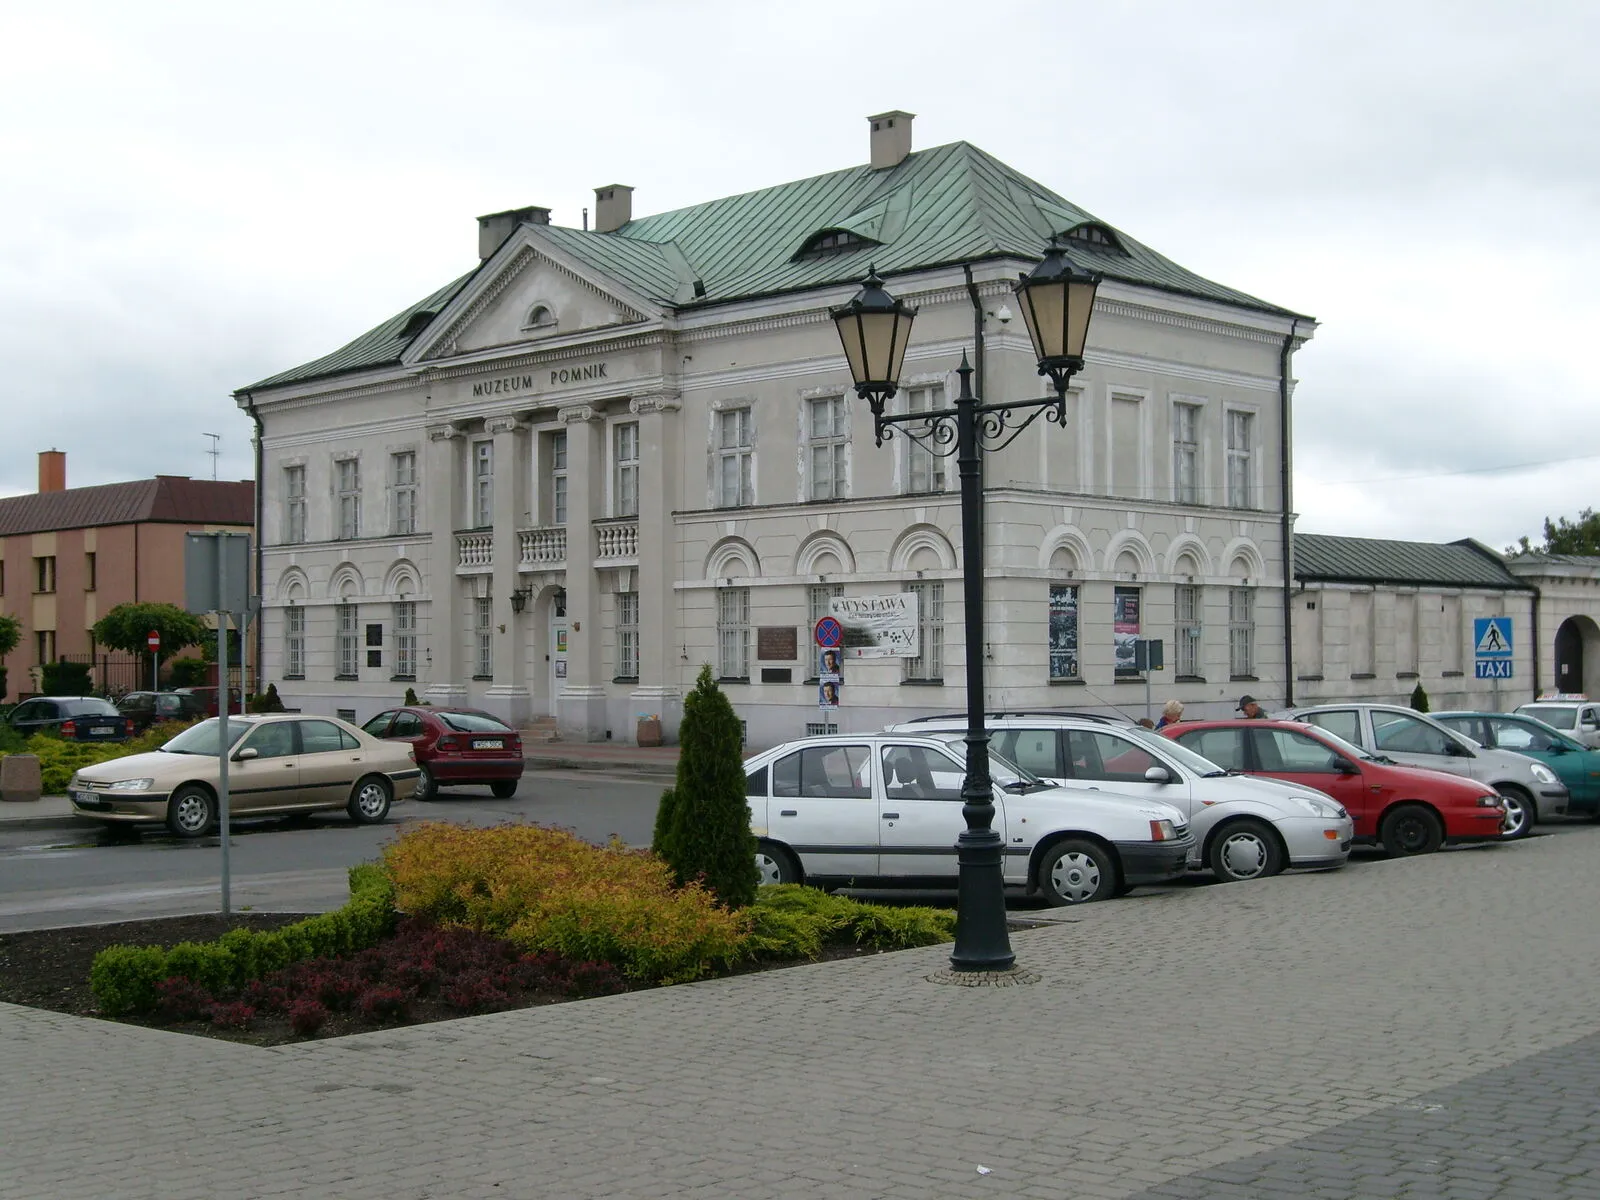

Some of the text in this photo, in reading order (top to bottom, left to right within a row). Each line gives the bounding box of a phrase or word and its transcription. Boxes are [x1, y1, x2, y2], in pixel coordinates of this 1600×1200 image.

[472, 363, 608, 397] MUZEUM POMNIK
[841, 598, 906, 612] WYSTAWA
[1476, 661, 1511, 677] TAXI
